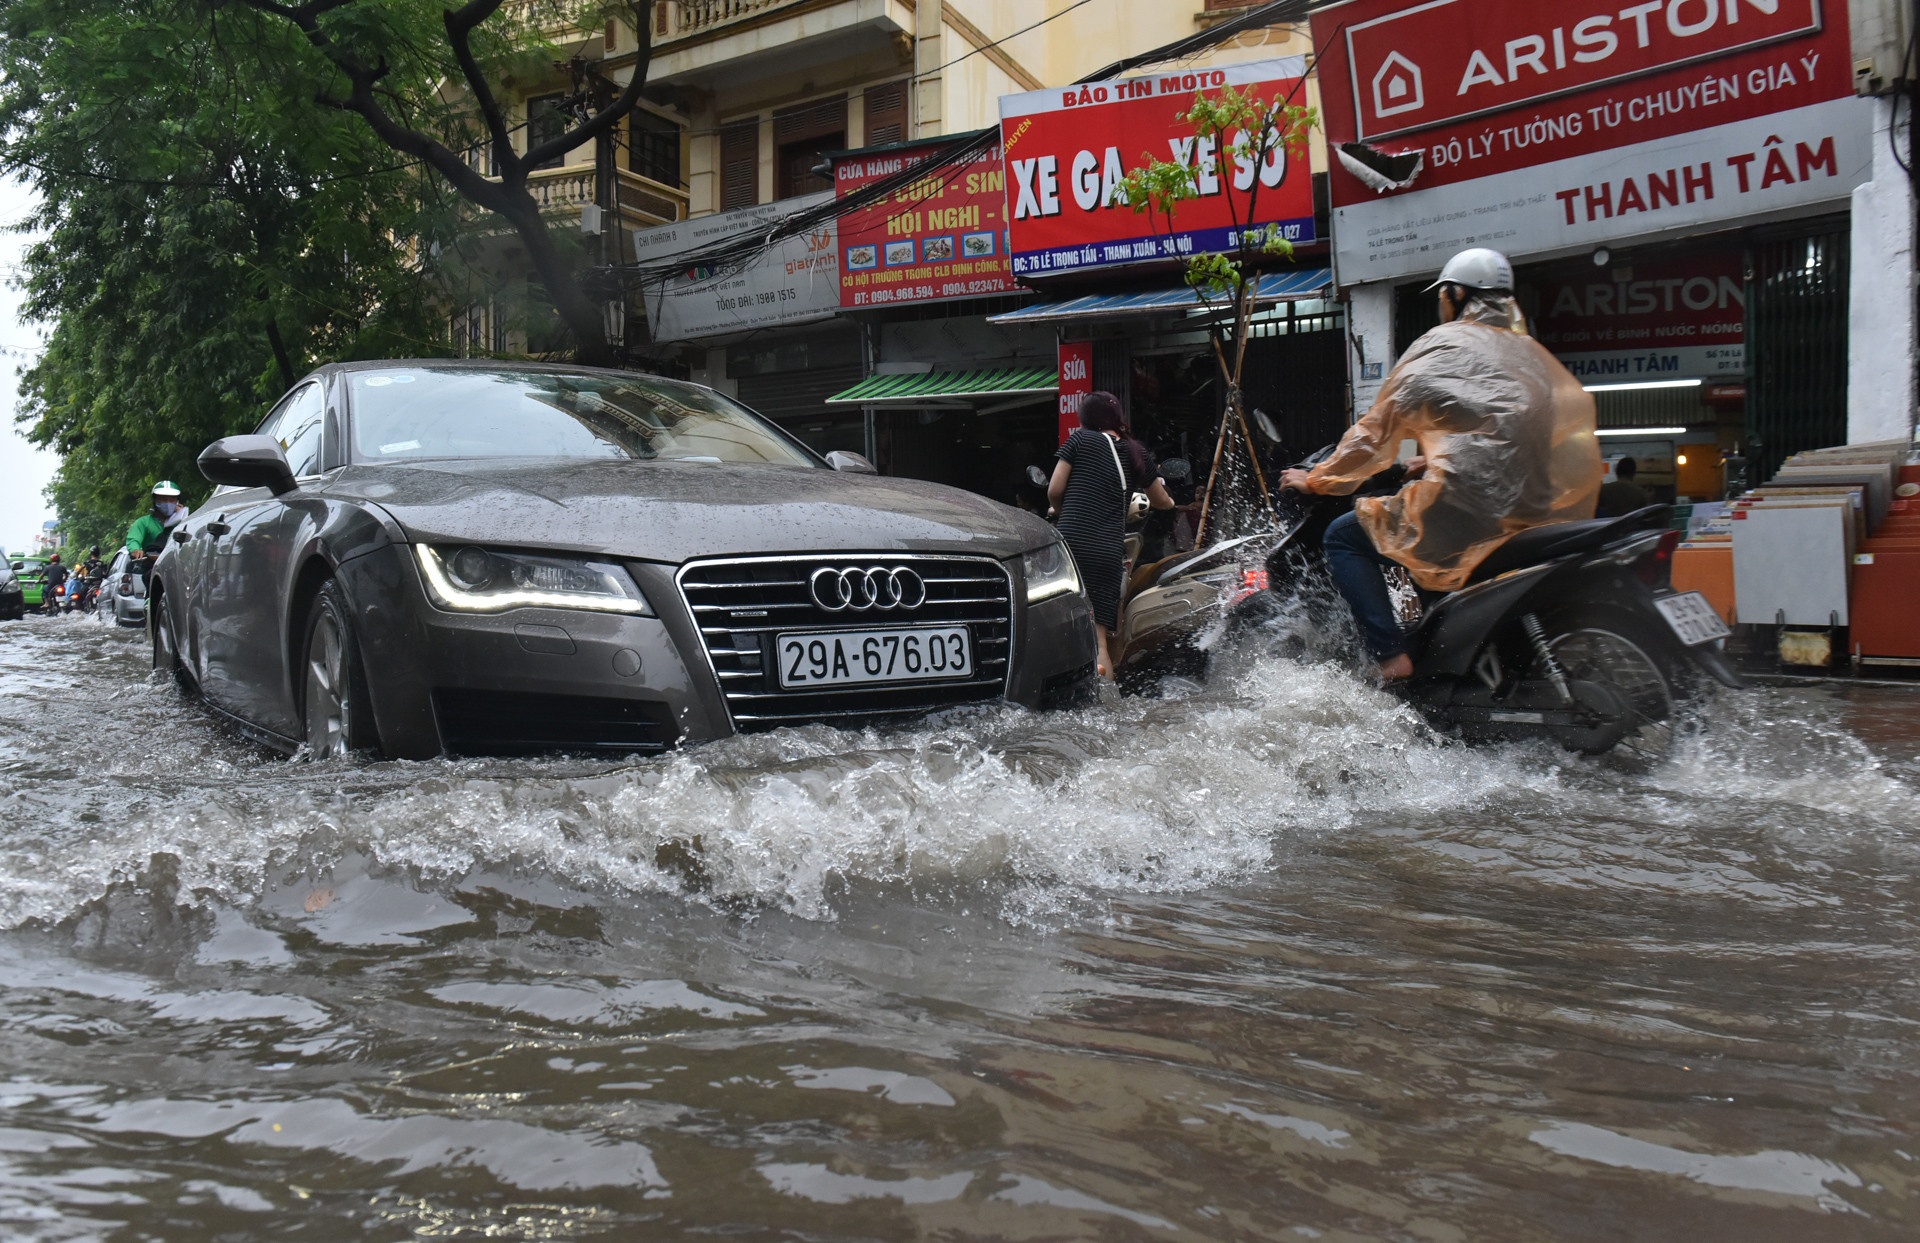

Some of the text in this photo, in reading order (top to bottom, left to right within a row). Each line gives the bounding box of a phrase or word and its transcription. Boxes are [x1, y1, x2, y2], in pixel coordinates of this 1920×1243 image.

[1062, 70, 1226, 107] BẢO TÍN MOTO
[1431, 48, 1821, 168] ĐỘ LÝ TƯỞNG TỪ CHUYÊN GIA Ý
[1003, 118, 1032, 155] CHUYÊN
[838, 160, 865, 180] CỬA
[867, 158, 902, 177] HÀNG
[1011, 154, 1060, 220] XE
[1071, 146, 1129, 212] GA
[1168, 133, 1220, 199] XE
[1555, 134, 1838, 226] THANH TÂM
[966, 170, 1003, 195] SIN
[887, 211, 921, 239] HỘI
[928, 205, 980, 231] NGHỊ
[1284, 224, 1301, 240] 027
[638, 236, 649, 248] CHI
[650, 232, 671, 247] NHÁNH
[1014, 256, 1027, 273] ĐC:
[1029, 255, 1040, 271] 76
[1040, 251, 1051, 269] LÊ
[1052, 250, 1079, 269] TRỌNG
[1080, 244, 1097, 264] TẤN
[1103, 244, 1132, 262] THANH
[1133, 240, 1157, 258] XUÂN
[842, 275, 854, 287] CÓ
[855, 272, 869, 288] HỘI
[872, 268, 903, 284] TRƯỜNG
[905, 266, 932, 281] TRONG
[934, 264, 950, 278] CLB
[952, 261, 974, 279] ĐỊNH
[716, 288, 796, 311] TỔNG ĐÀI: 1900 1515
[854, 292, 869, 305] ĐT:
[871, 285, 934, 303] 0904.968.594
[942, 279, 1005, 297] 0904.923474
[1549, 275, 1745, 318] ARISTON
[1655, 321, 1696, 337] NƯỚC
[1701, 318, 1744, 334] NÓNG
[1063, 354, 1086, 380] SỬA
[1634, 352, 1679, 373] TÂM
[1060, 390, 1088, 414] CHỮ
[785, 633, 966, 682] 29A-676.03
